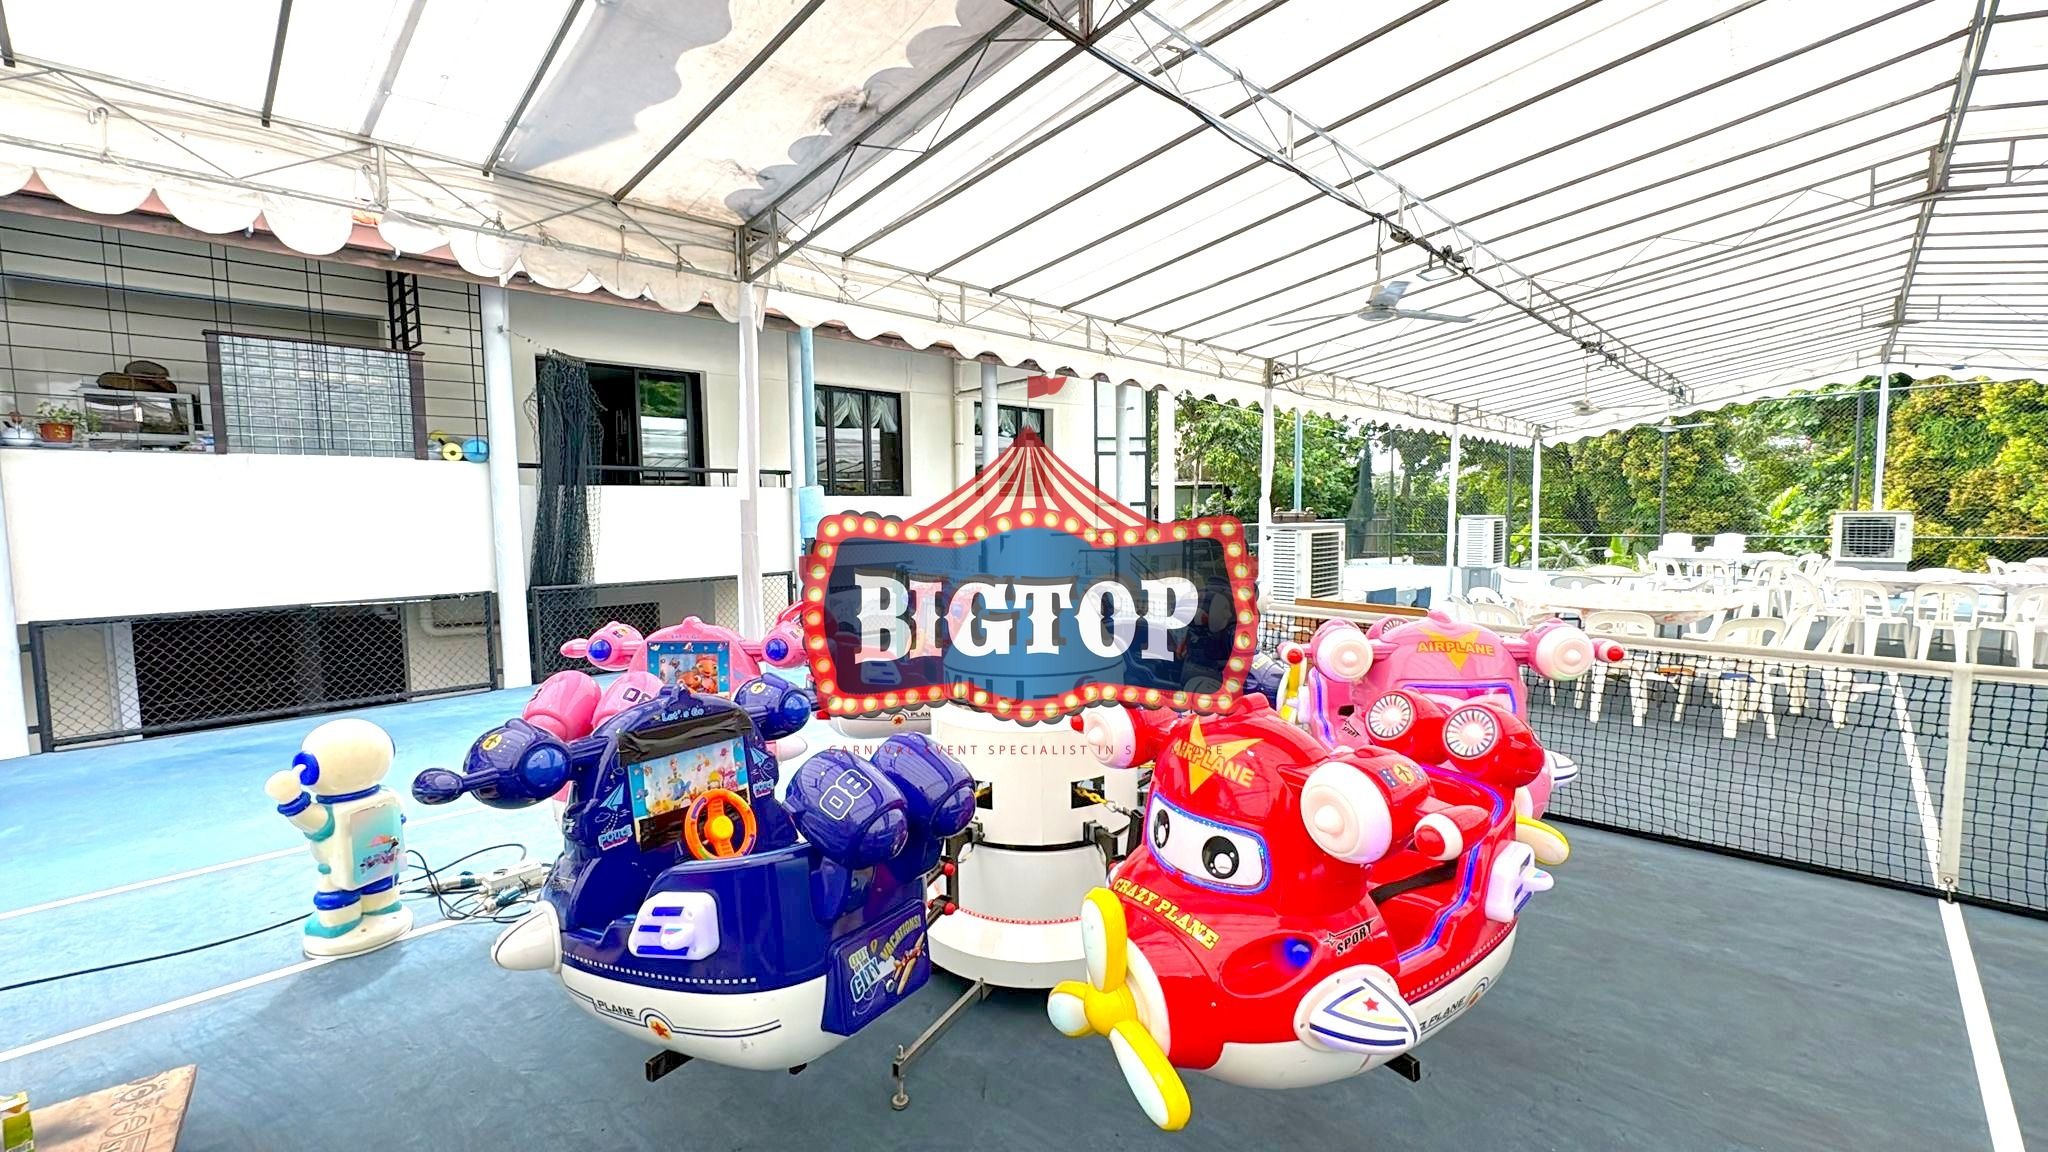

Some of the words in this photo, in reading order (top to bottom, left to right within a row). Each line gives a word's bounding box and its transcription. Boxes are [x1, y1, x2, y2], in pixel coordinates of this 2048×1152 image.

[1417, 640, 1496, 656] AIRPLANE
[1171, 738, 1256, 789] AIRPLANE
[819, 769, 872, 820] 08
[1113, 877, 1160, 906] CRAZY
[1153, 897, 1221, 951] PLANE
[1335, 919, 1376, 956] SPORT
[850, 957, 881, 1001] CITY
[597, 1000, 636, 1018] PLANE
[1429, 996, 1467, 1026] PLANE
